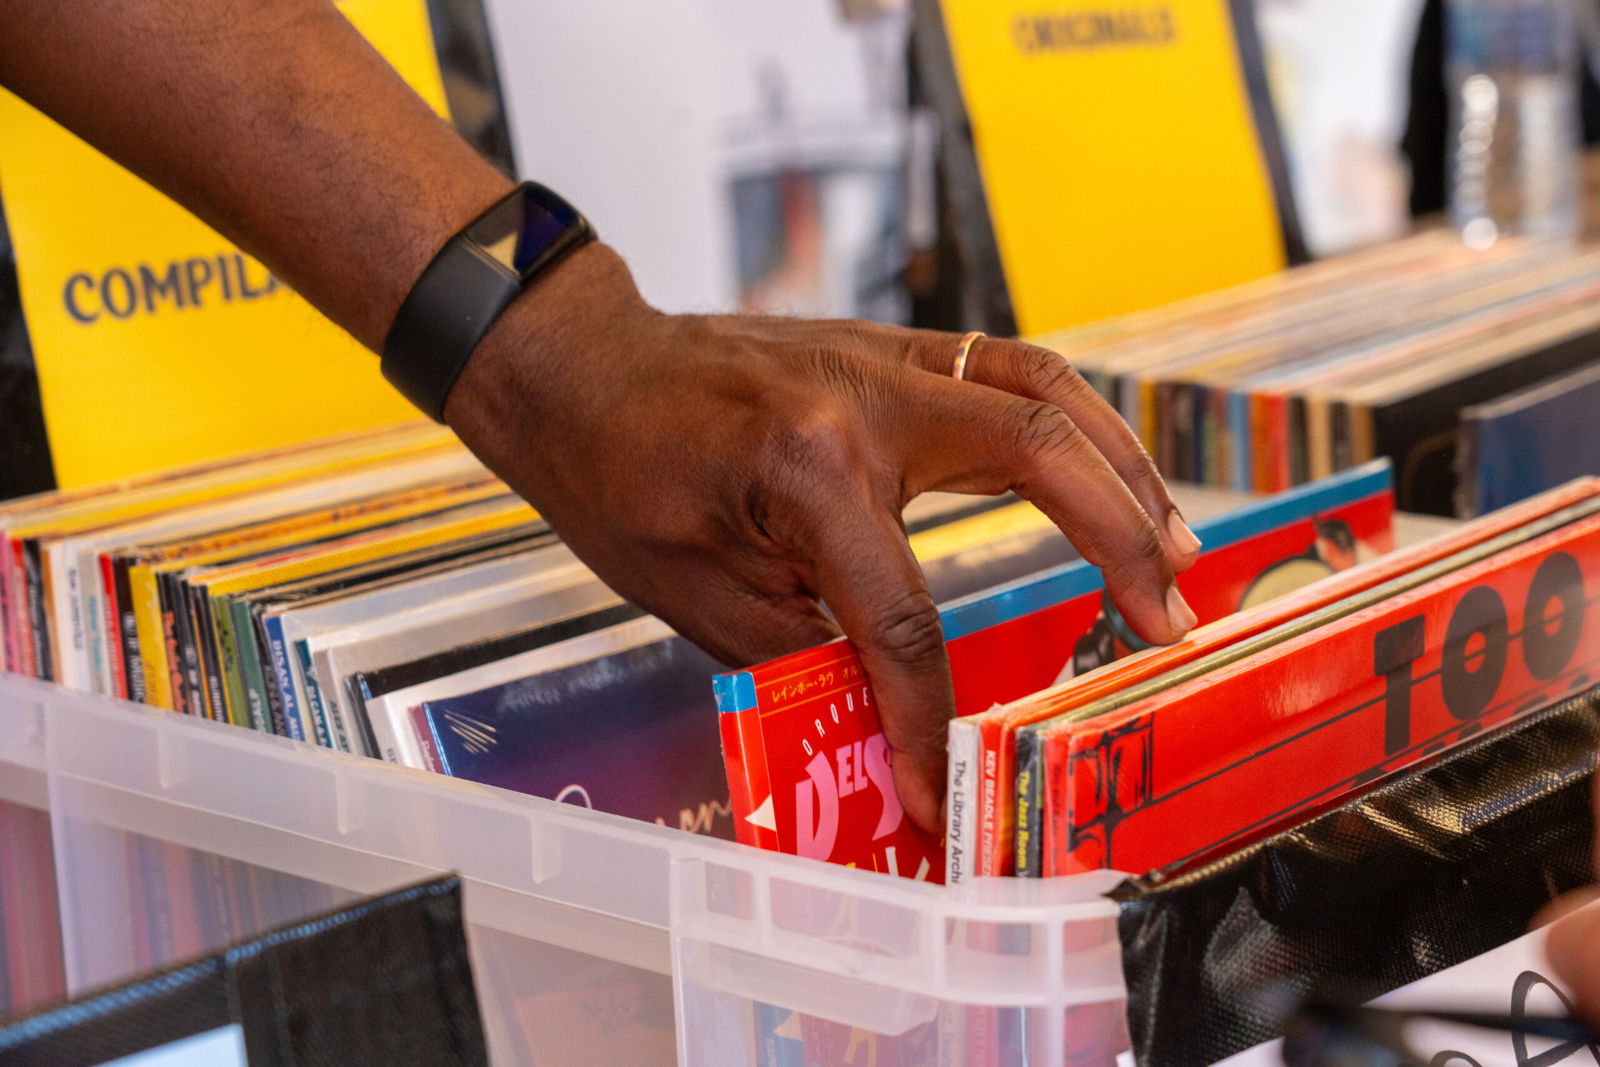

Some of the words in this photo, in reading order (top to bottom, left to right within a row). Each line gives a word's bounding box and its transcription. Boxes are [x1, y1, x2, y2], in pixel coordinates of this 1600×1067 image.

[62, 252, 279, 325] COMPIL
[273, 640, 290, 688] IHSAN
[953, 761, 966, 786] The
[985, 750, 996, 777] KEV
[1018, 771, 1031, 796] The
[950, 791, 965, 842] Library
[984, 779, 995, 831] BEADLE
[1018, 797, 1030, 828] Jazz
[1018, 831, 1030, 869] Room
